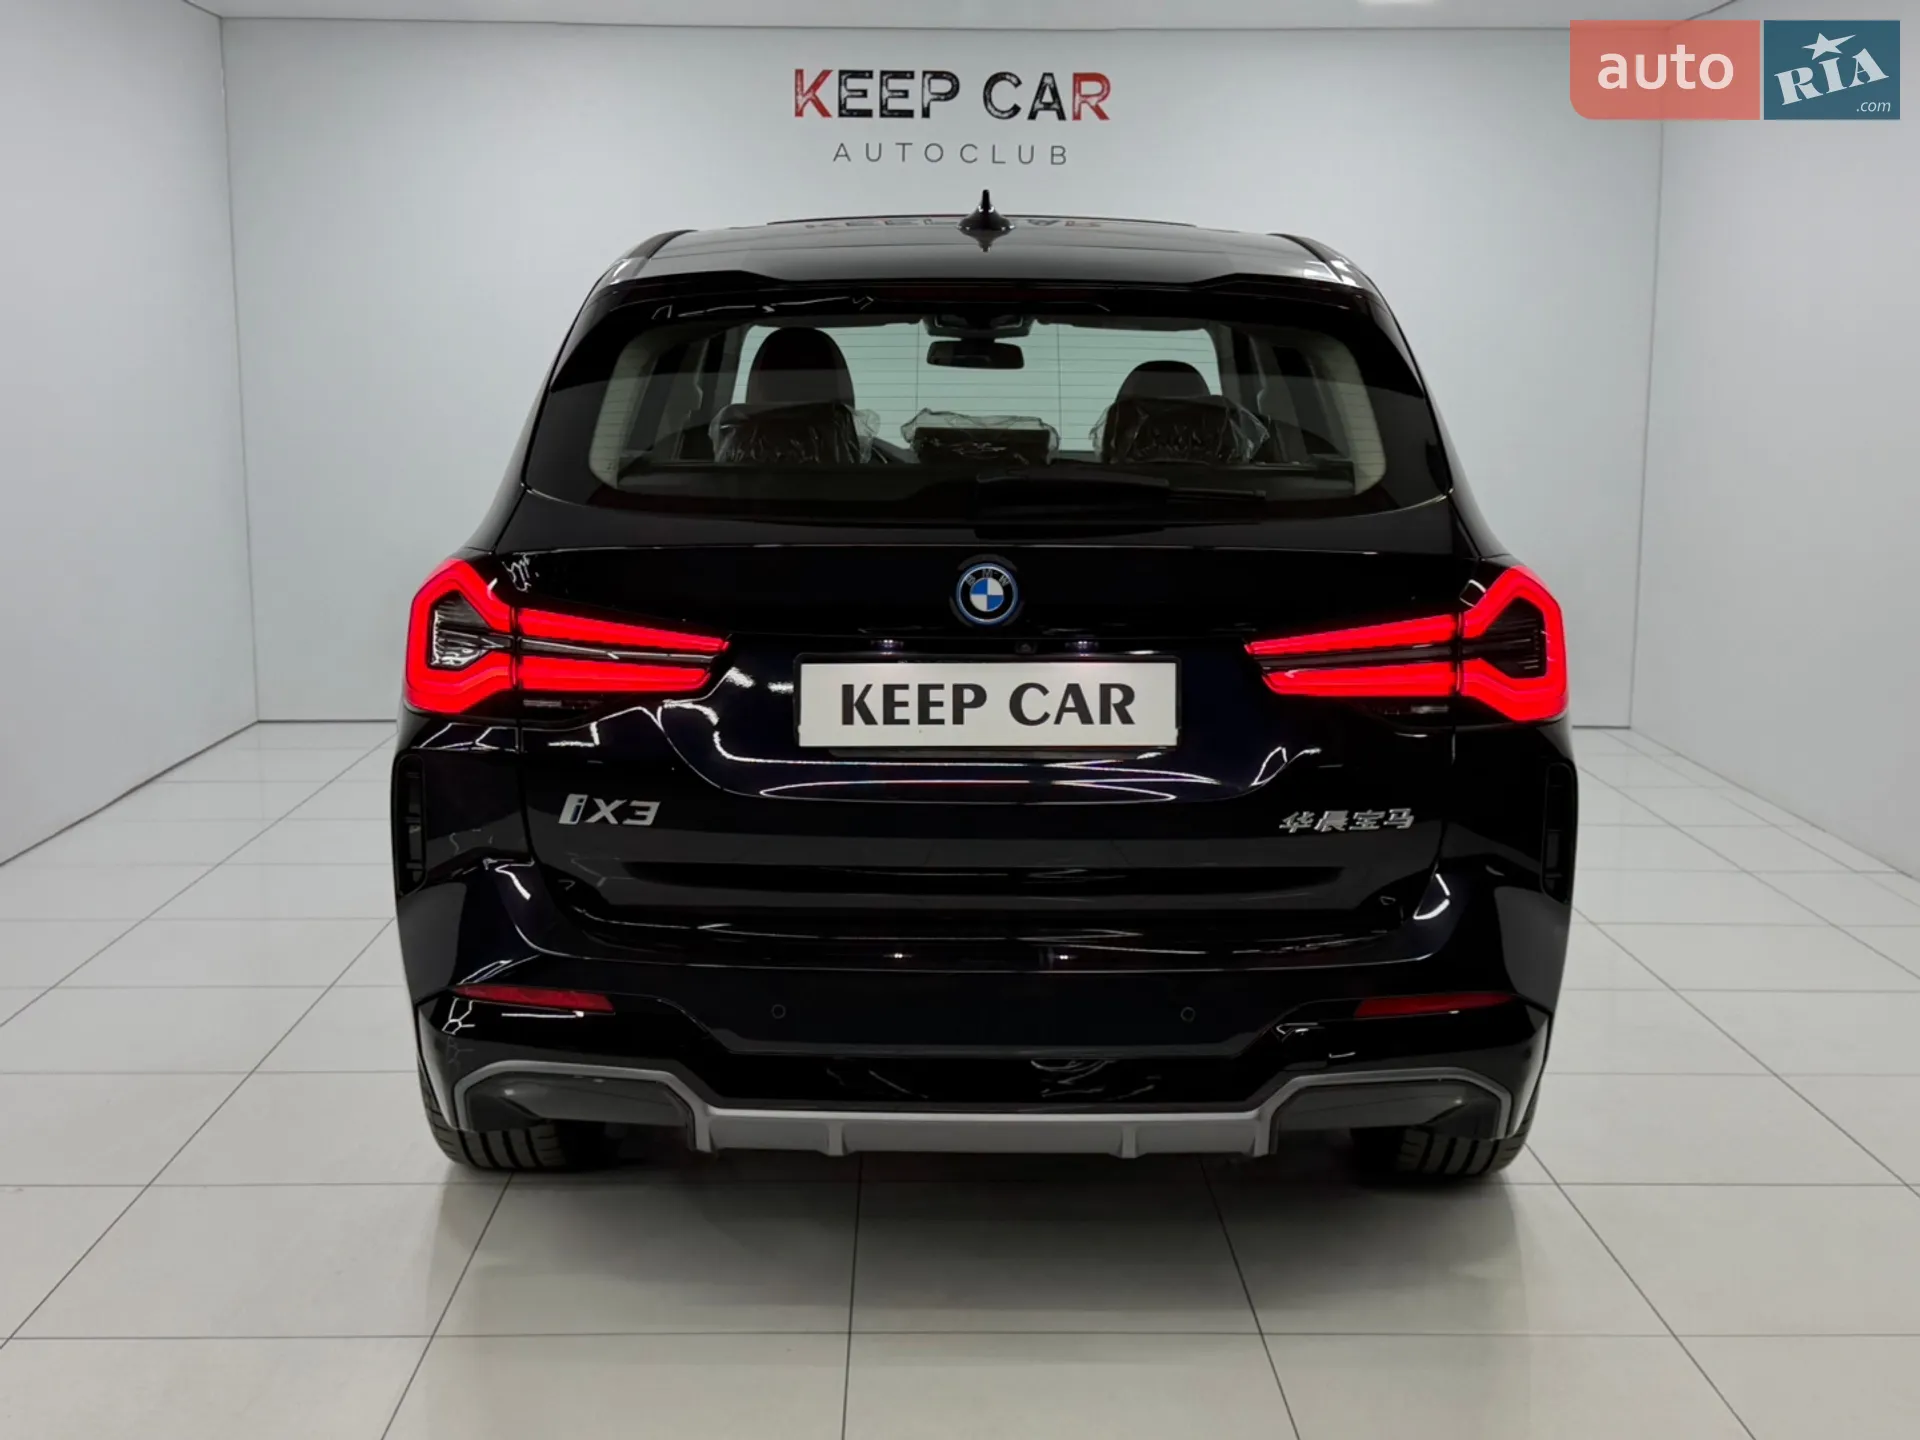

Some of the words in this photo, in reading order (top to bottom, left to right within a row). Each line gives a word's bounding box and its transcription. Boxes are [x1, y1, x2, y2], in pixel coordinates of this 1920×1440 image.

[794, 68, 960, 118] KEEP
[982, 72, 1111, 121] CAR
[833, 142, 1067, 165] AUTOCLUB
[965, 568, 1010, 587] BMW
[841, 683, 987, 726] KEEP
[1009, 682, 1136, 726] CAR
[1279, 808, 1415, 833] 华晨宝马
